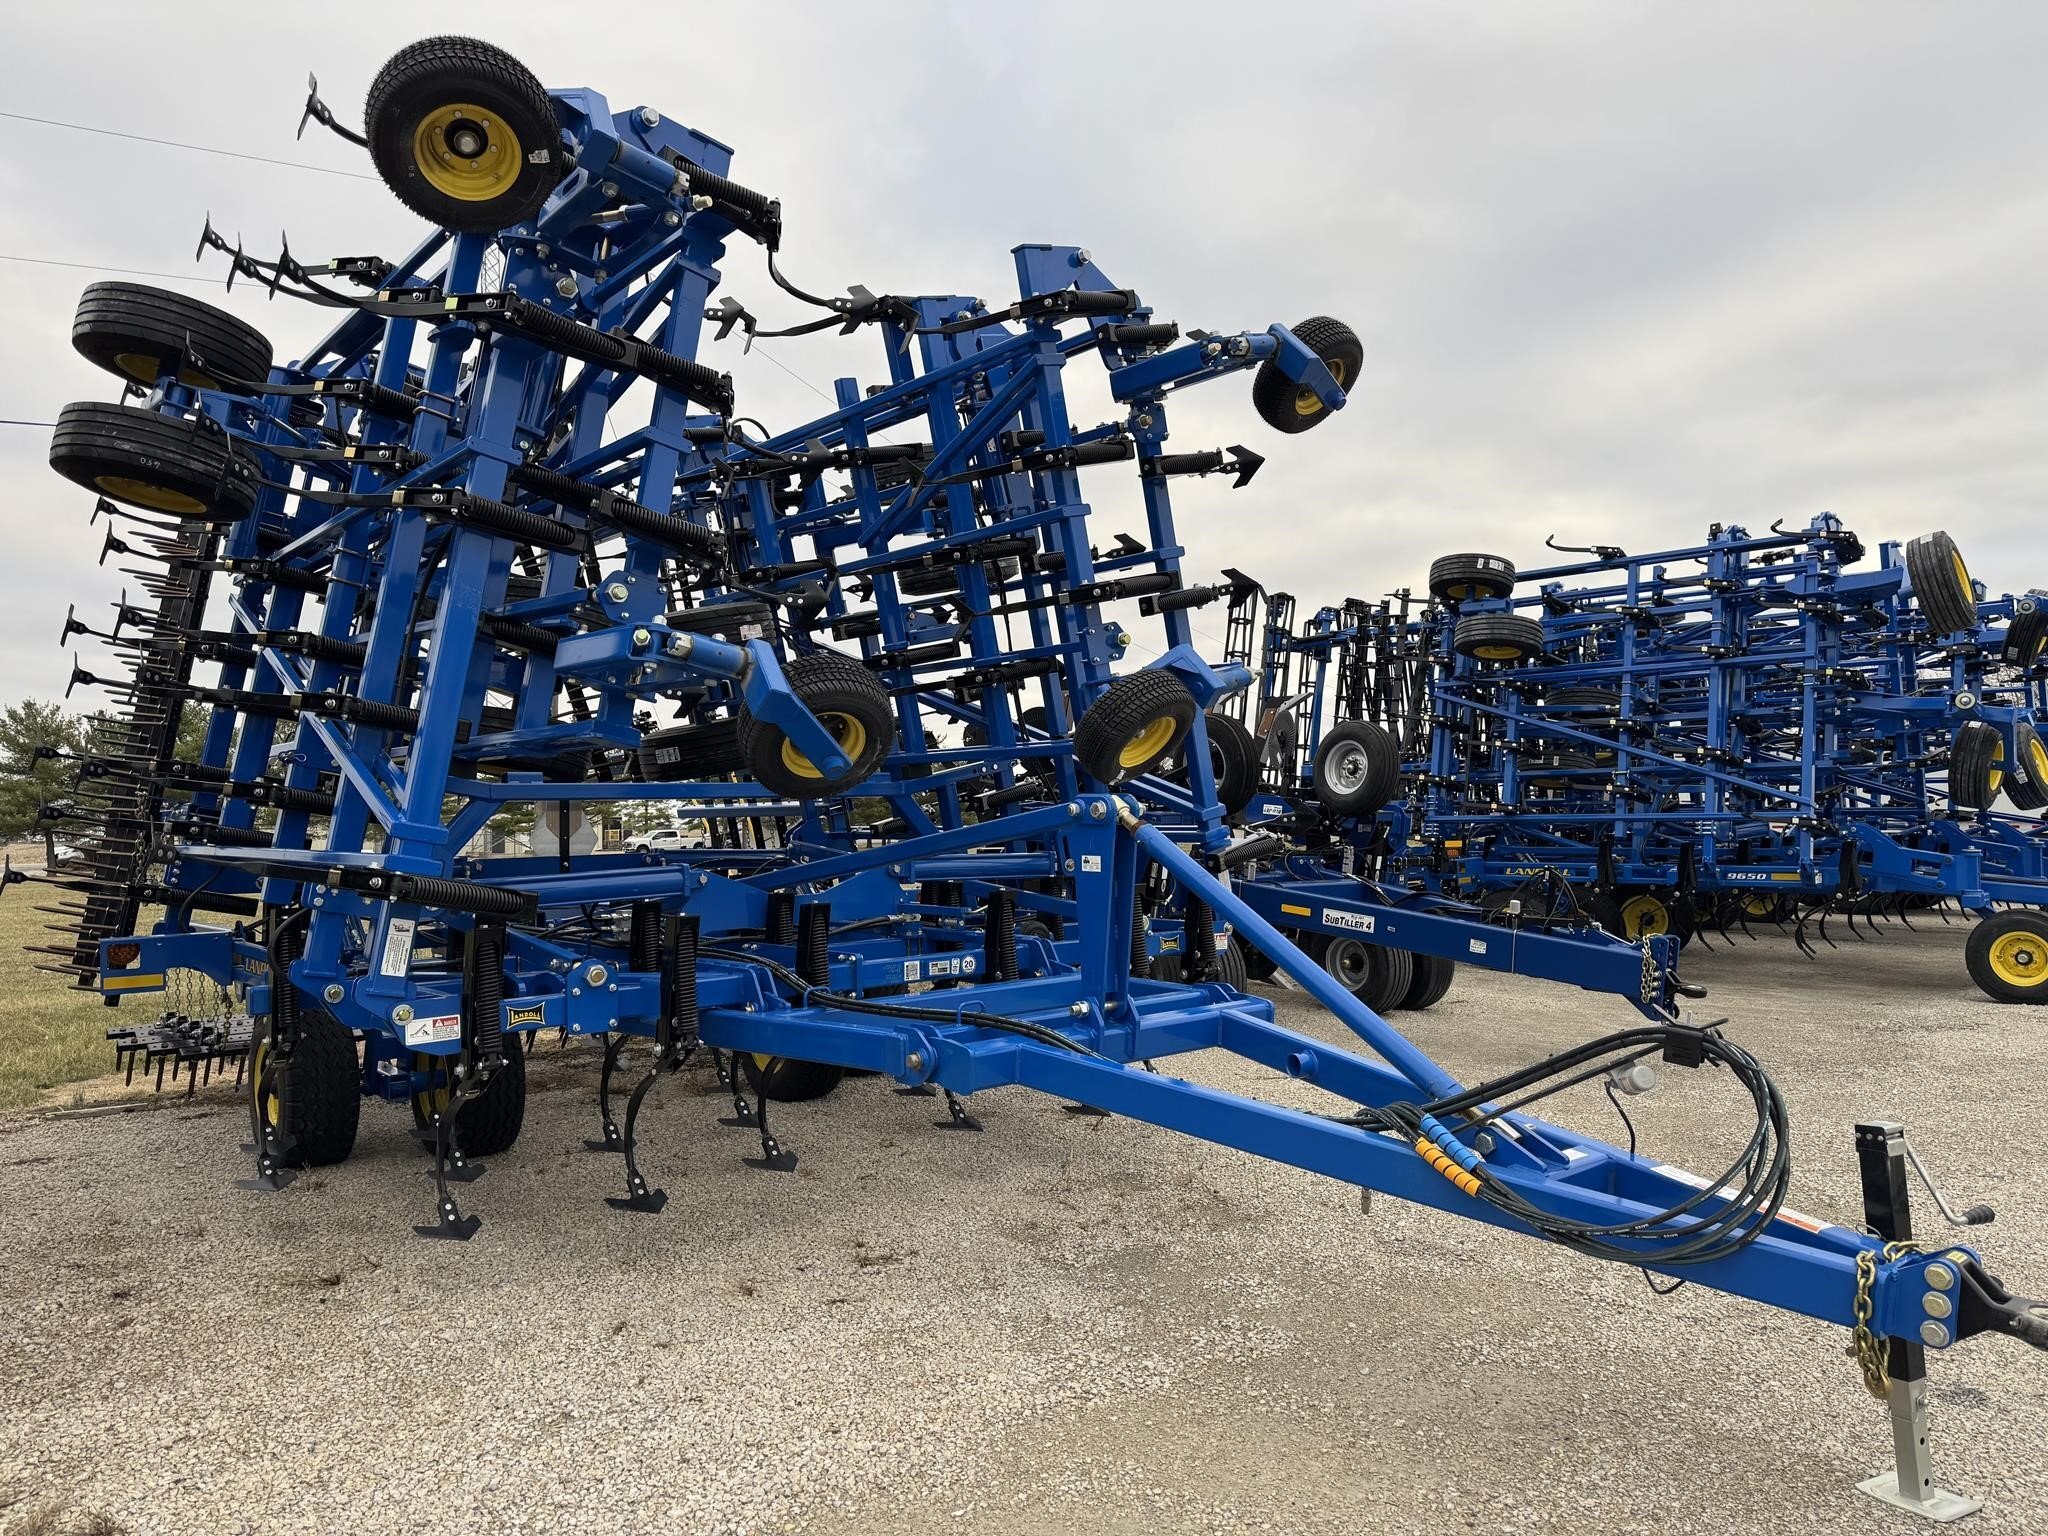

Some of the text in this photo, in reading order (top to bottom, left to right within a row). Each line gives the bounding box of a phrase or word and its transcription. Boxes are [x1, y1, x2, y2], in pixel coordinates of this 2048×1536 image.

[1726, 872, 1767, 880] 9650
[1365, 921, 1372, 931] 4
[964, 960, 974, 968] 20
[511, 1010, 541, 1023] LANDOLL
